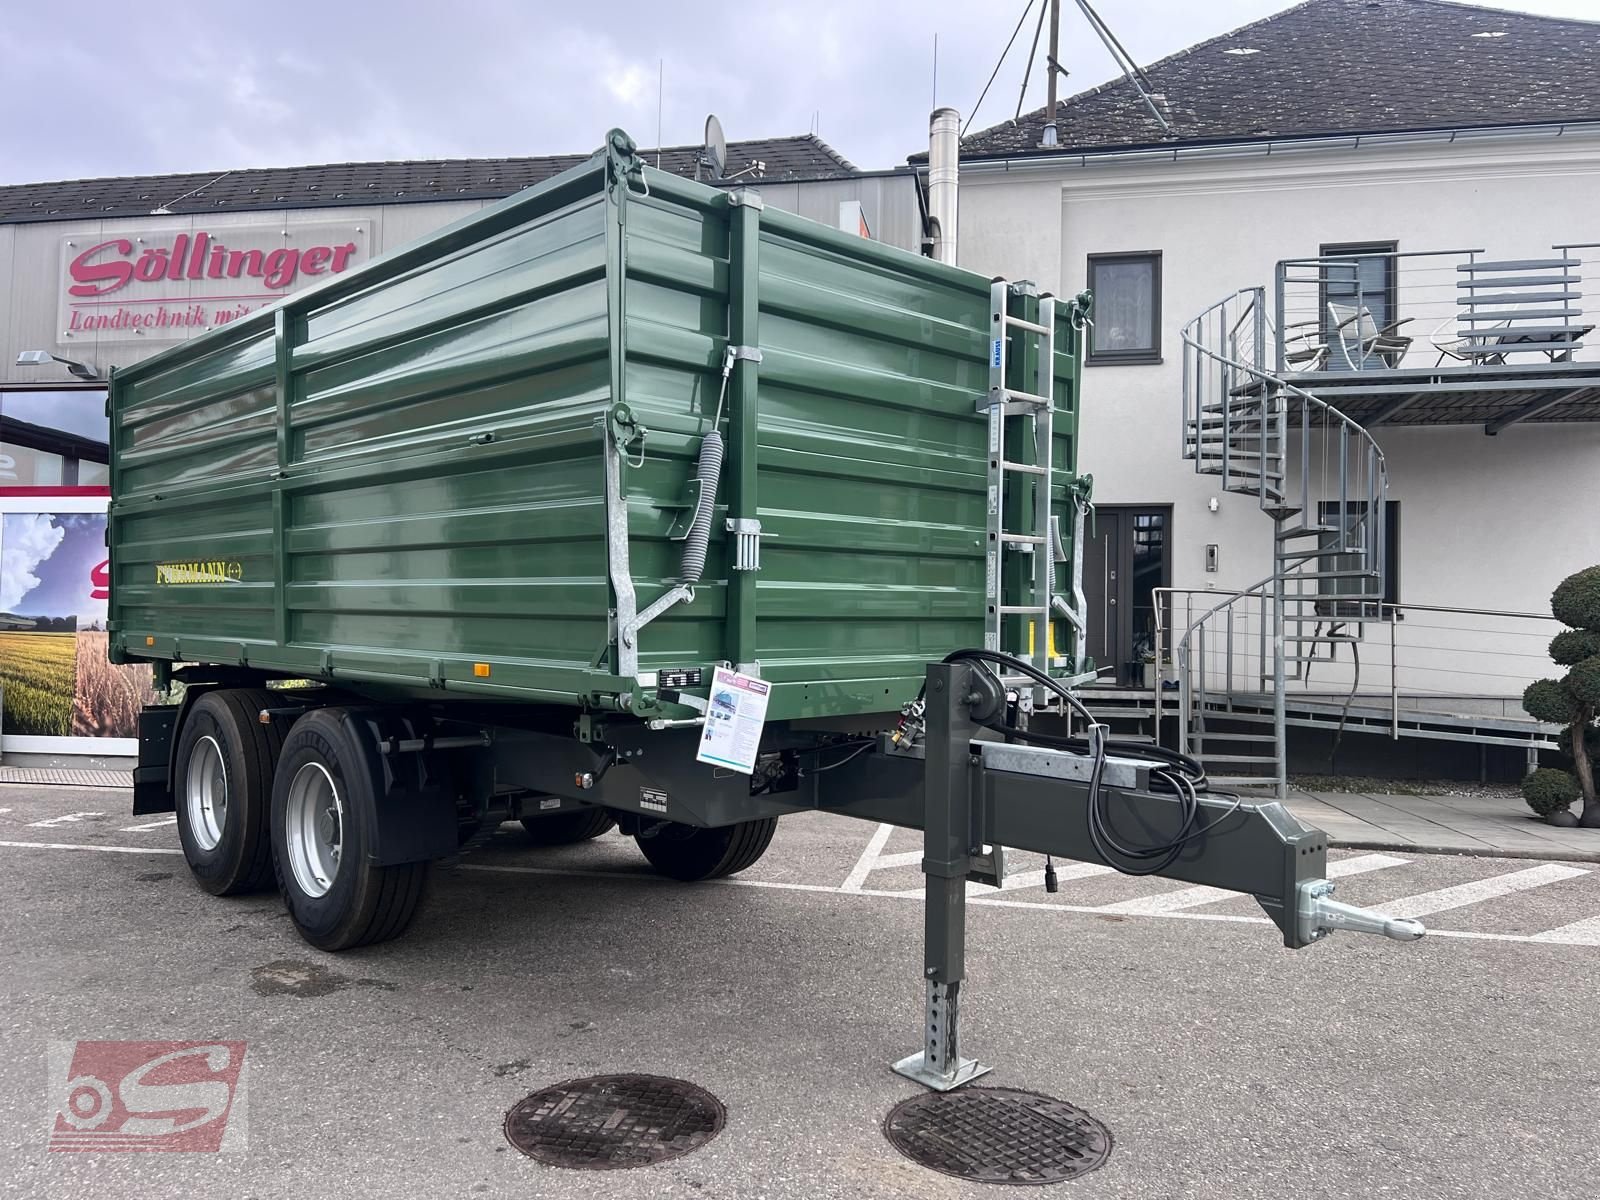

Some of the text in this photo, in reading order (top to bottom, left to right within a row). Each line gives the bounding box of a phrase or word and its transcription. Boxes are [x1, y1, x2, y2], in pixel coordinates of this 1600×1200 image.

[69, 232, 357, 296] Söllinger
[69, 304, 250, 330] Landtechnik mit
[156, 562, 225, 584] FUHRMANN
